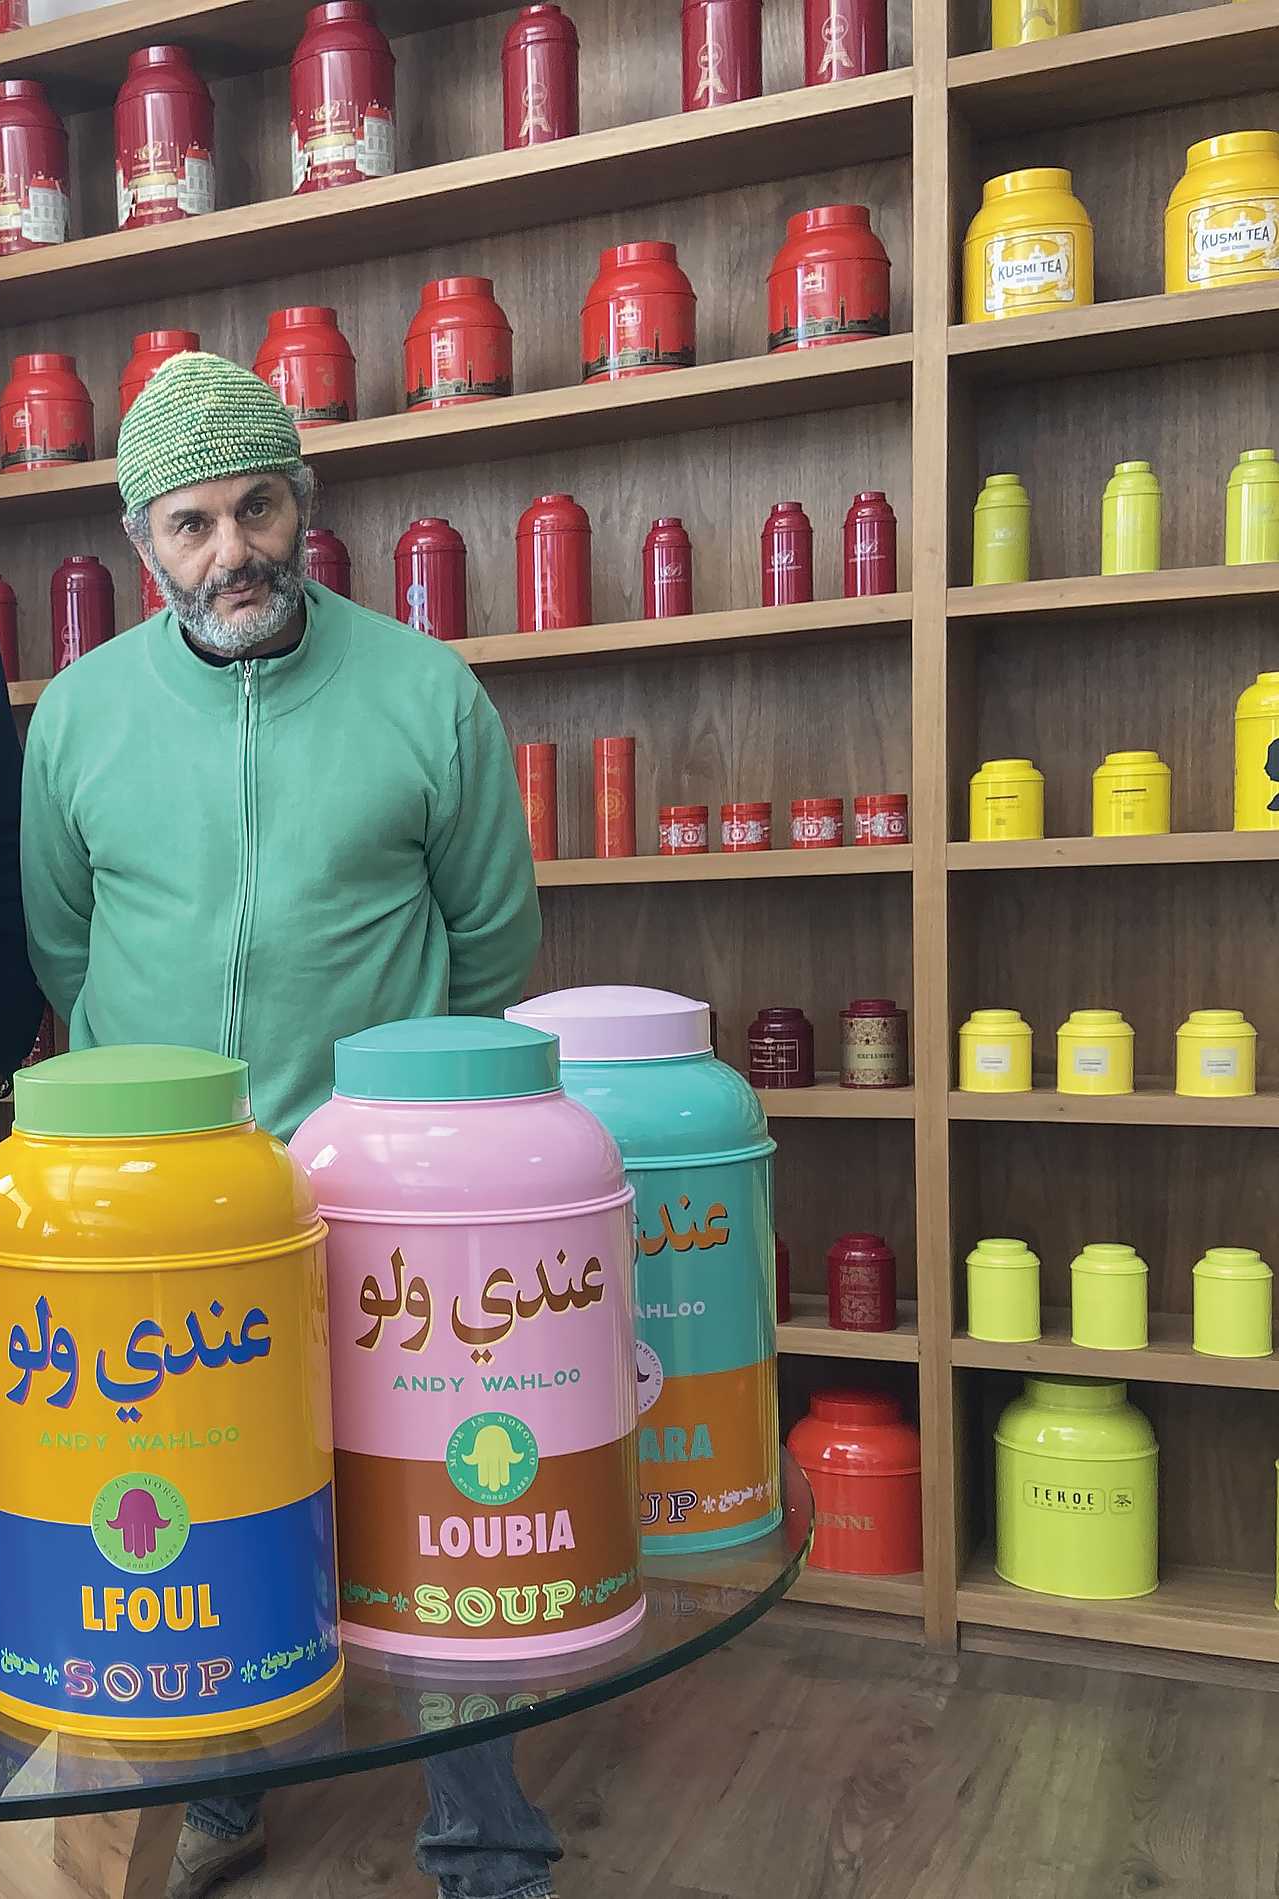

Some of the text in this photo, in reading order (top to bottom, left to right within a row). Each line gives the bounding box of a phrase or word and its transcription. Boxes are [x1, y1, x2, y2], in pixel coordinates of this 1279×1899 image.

[1202, 231, 1241, 251] KUSMI
[1246, 225, 1269, 242] TEA
[998, 263, 1036, 281] KUSMI
[1040, 258, 1062, 274] TEA
[355, 1247, 604, 1365] عندي ولو
[635, 1300, 706, 1320] AHLOO
[5, 1295, 272, 1424] عندي ولو
[392, 1368, 581, 1393] ANDY WAHLOO
[636, 1342, 662, 1386] OROCCO
[39, 1426, 240, 1452] ANDY WAHLOO
[448, 1415, 536, 1470] MADE IN MOROCCO
[639, 1424, 714, 1463] ARA
[94, 1477, 185, 1532] MADE IN MOROCCO
[1032, 1486, 1094, 1505] TEKOE
[418, 1508, 575, 1559] LOUBIA
[81, 1583, 221, 1633] LFOUL
[414, 1579, 577, 1628] SOUP
[64, 1656, 235, 1703] SOUP
